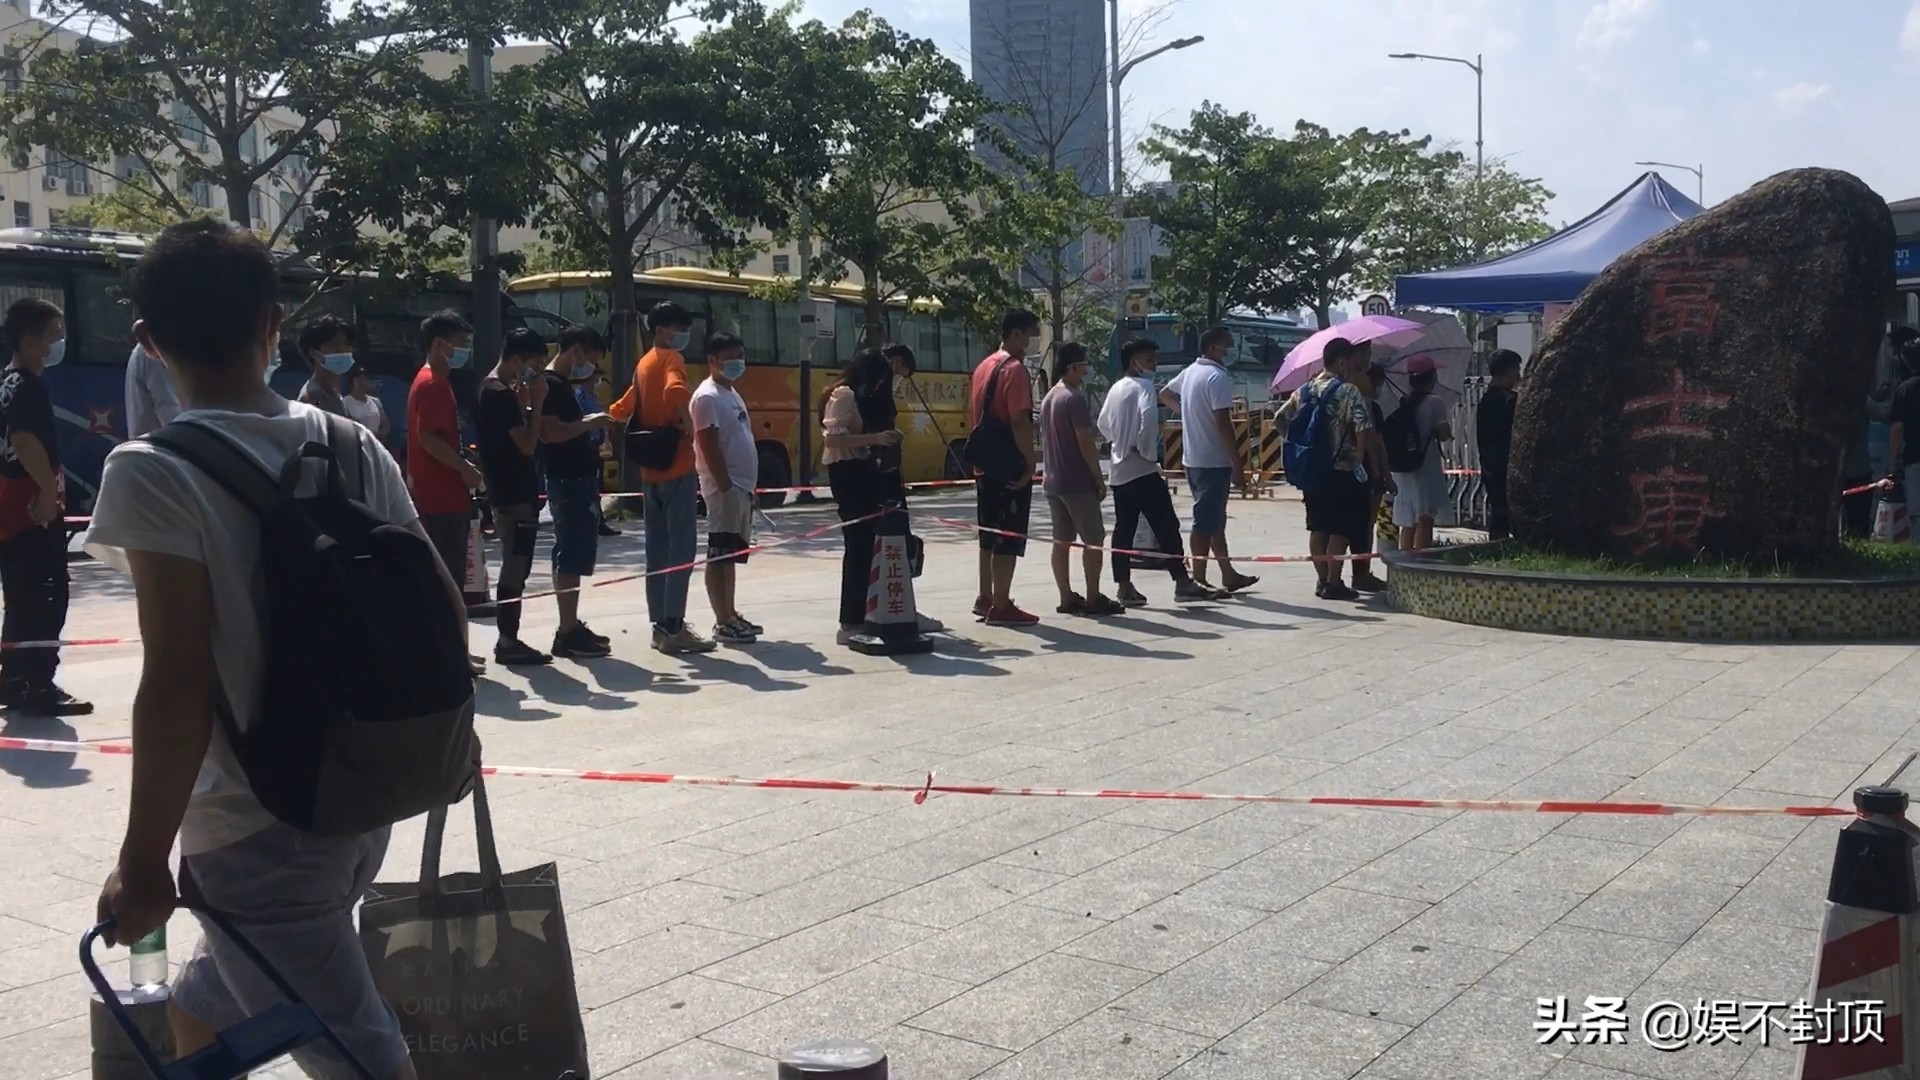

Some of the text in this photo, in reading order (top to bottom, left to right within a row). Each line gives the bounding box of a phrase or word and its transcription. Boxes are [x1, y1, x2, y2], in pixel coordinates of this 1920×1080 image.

[1369, 302, 1385, 315] 50
[1611, 246, 1749, 556] 富士康
[884, 545, 905, 616] 禁止停车
[402, 985, 526, 1016] ORDINARY
[405, 1023, 530, 1054] ELEGANCE
